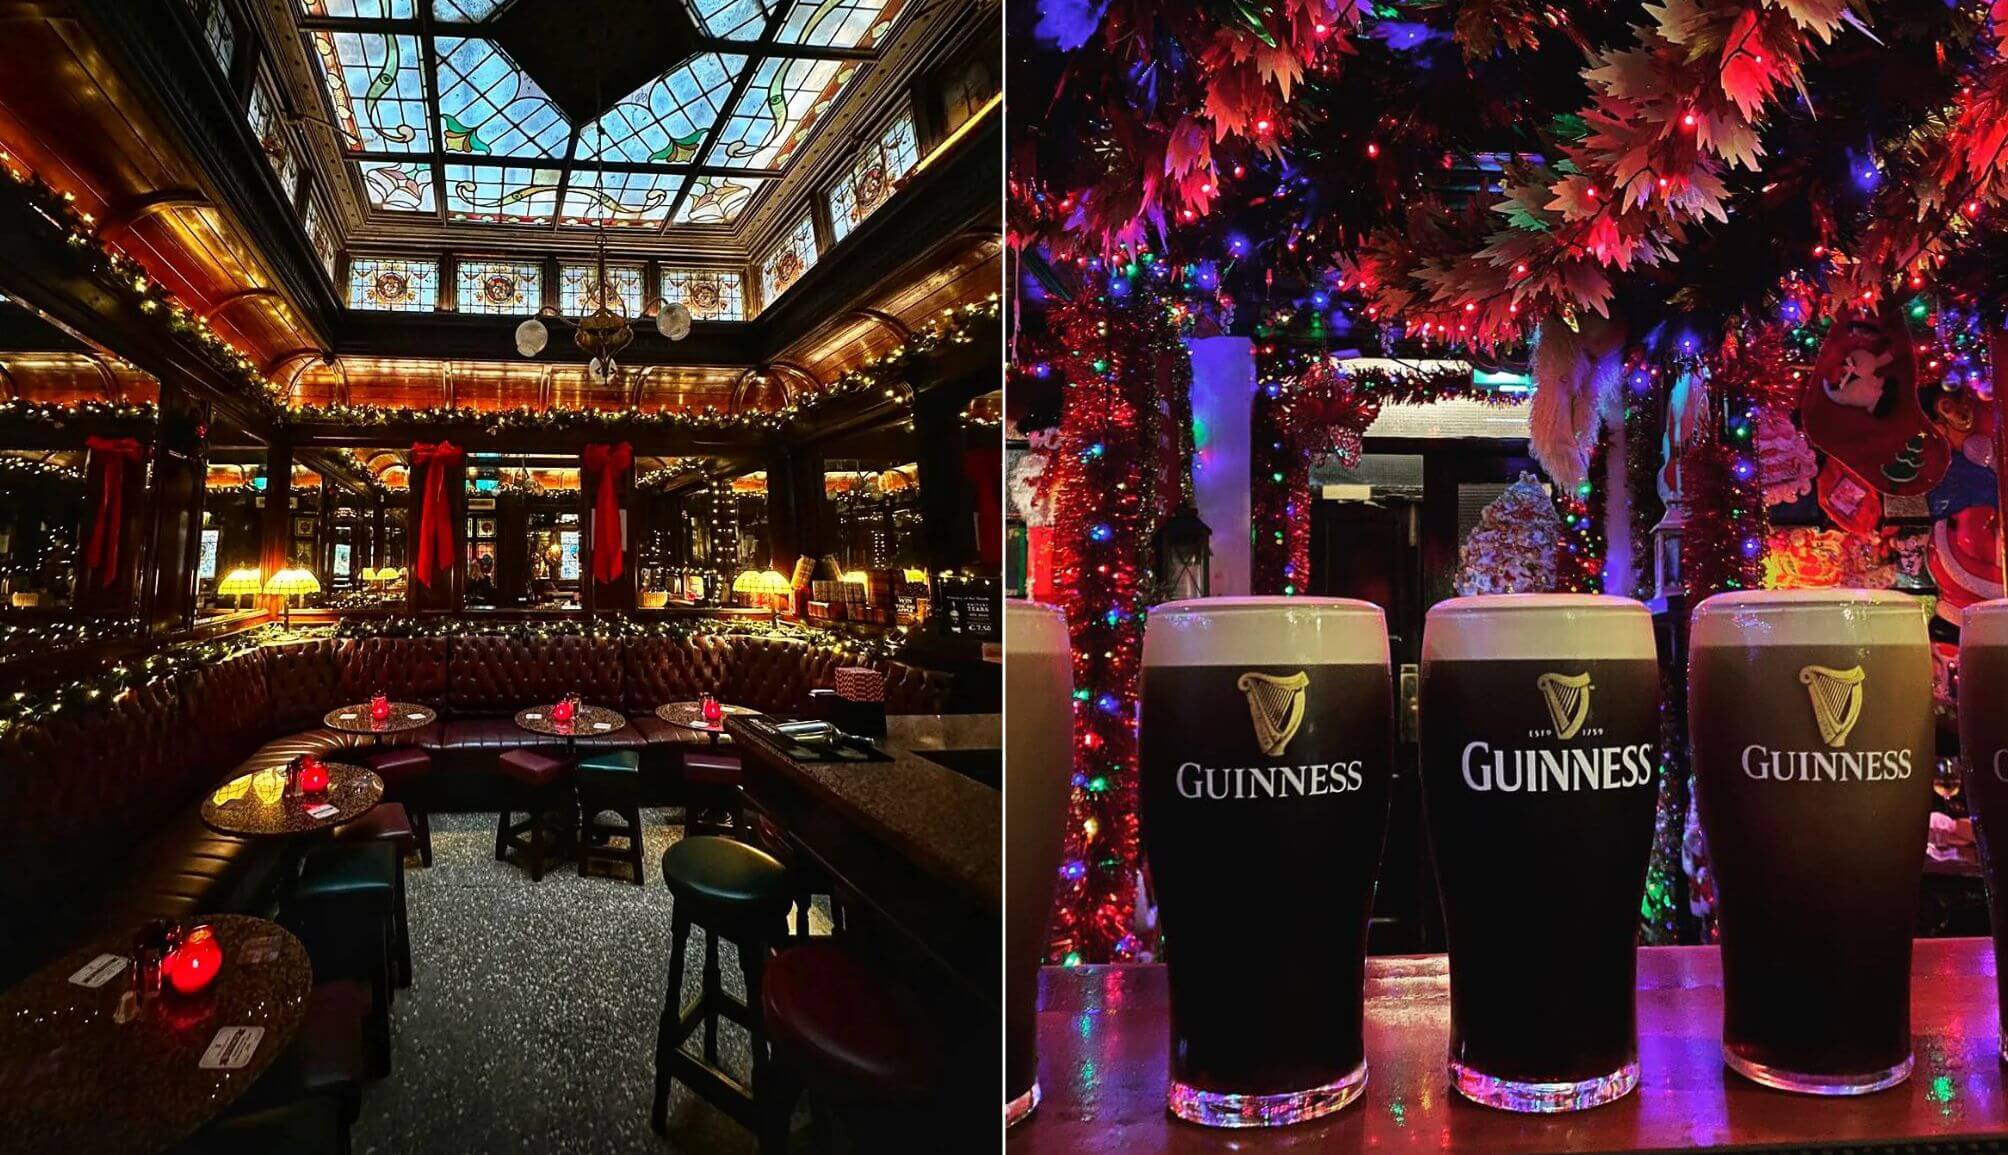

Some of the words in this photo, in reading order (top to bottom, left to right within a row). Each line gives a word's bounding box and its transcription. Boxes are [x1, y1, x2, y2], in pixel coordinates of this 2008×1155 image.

[1582, 728, 1604, 737] 1759
[1176, 761, 1363, 800] GUINNESS
[1461, 741, 1653, 793] GUINNESS
[1741, 745, 1912, 783] GUINNESS
